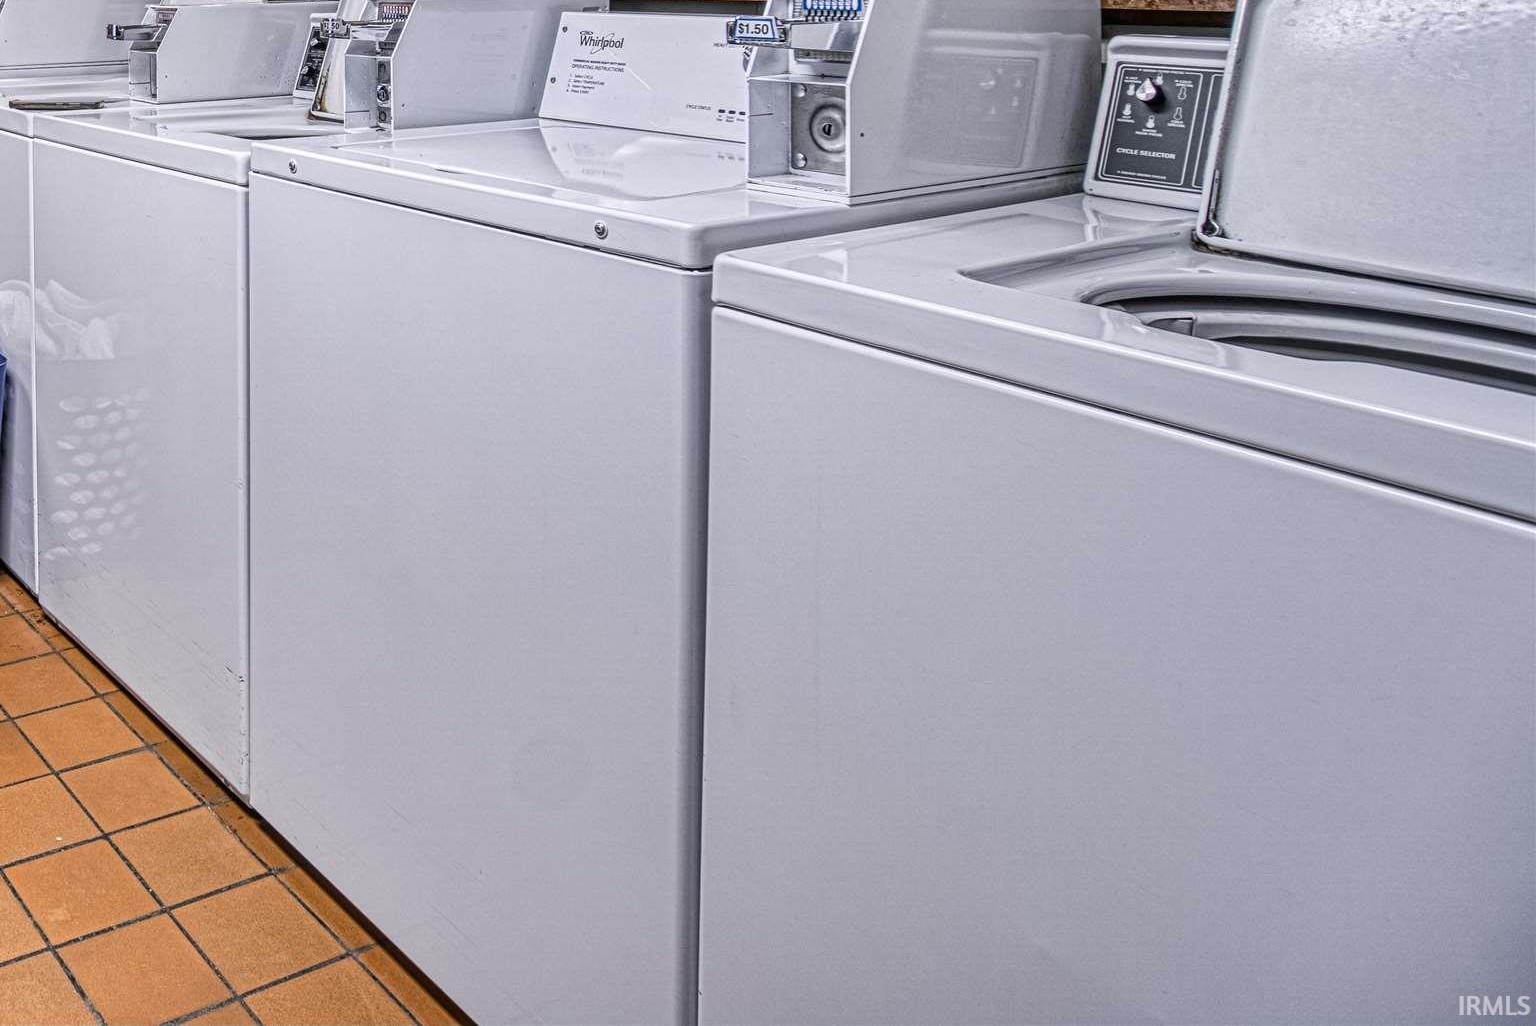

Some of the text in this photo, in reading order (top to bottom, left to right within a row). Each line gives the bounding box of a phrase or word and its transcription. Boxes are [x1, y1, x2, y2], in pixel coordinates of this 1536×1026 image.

[738, 23, 769, 34] $1.50
[580, 35, 624, 50] Whirlpool
[1116, 147, 1176, 159] CYCLE SELECTOR
